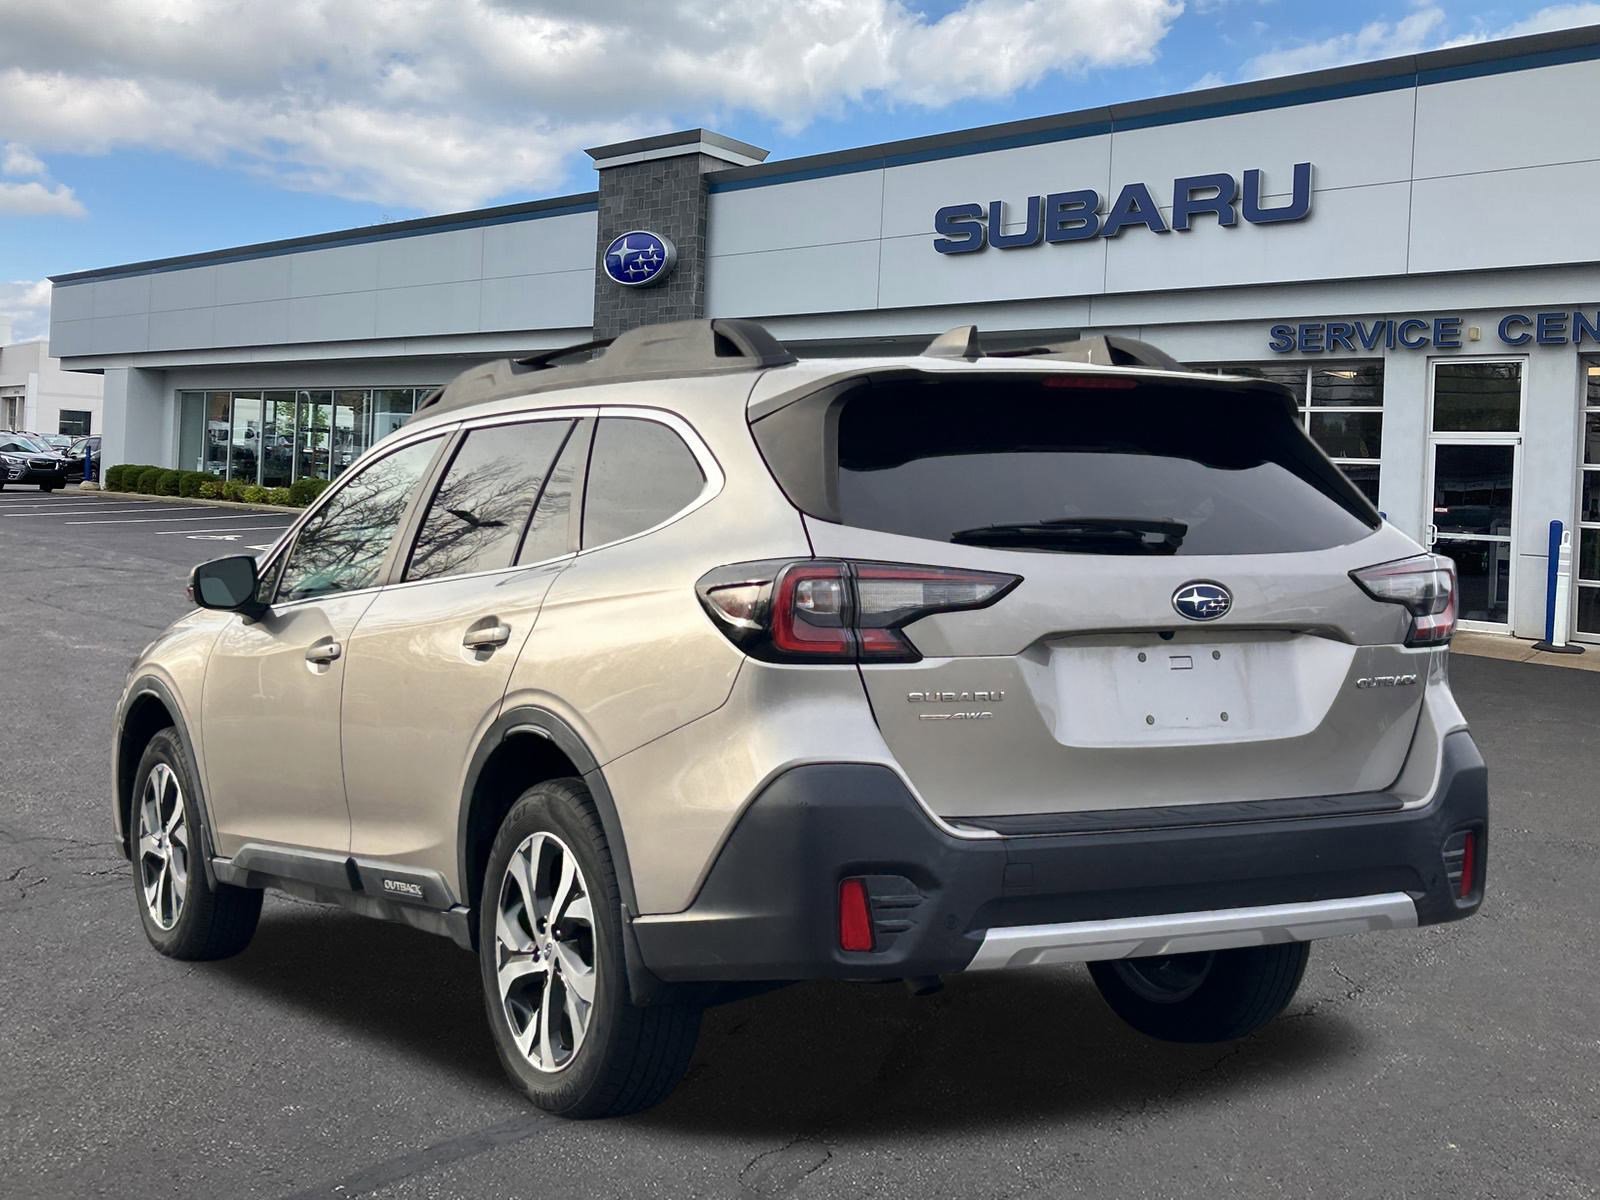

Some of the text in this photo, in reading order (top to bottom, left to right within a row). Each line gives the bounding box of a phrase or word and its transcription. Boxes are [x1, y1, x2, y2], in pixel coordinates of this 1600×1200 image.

[933, 161, 1313, 255] SUBARU
[1269, 310, 1600, 353] SERVICE CEN
[1356, 673, 1417, 689] OUTBACK
[907, 691, 1005, 703] SUBARU
[384, 879, 422, 895] OUTBACK
